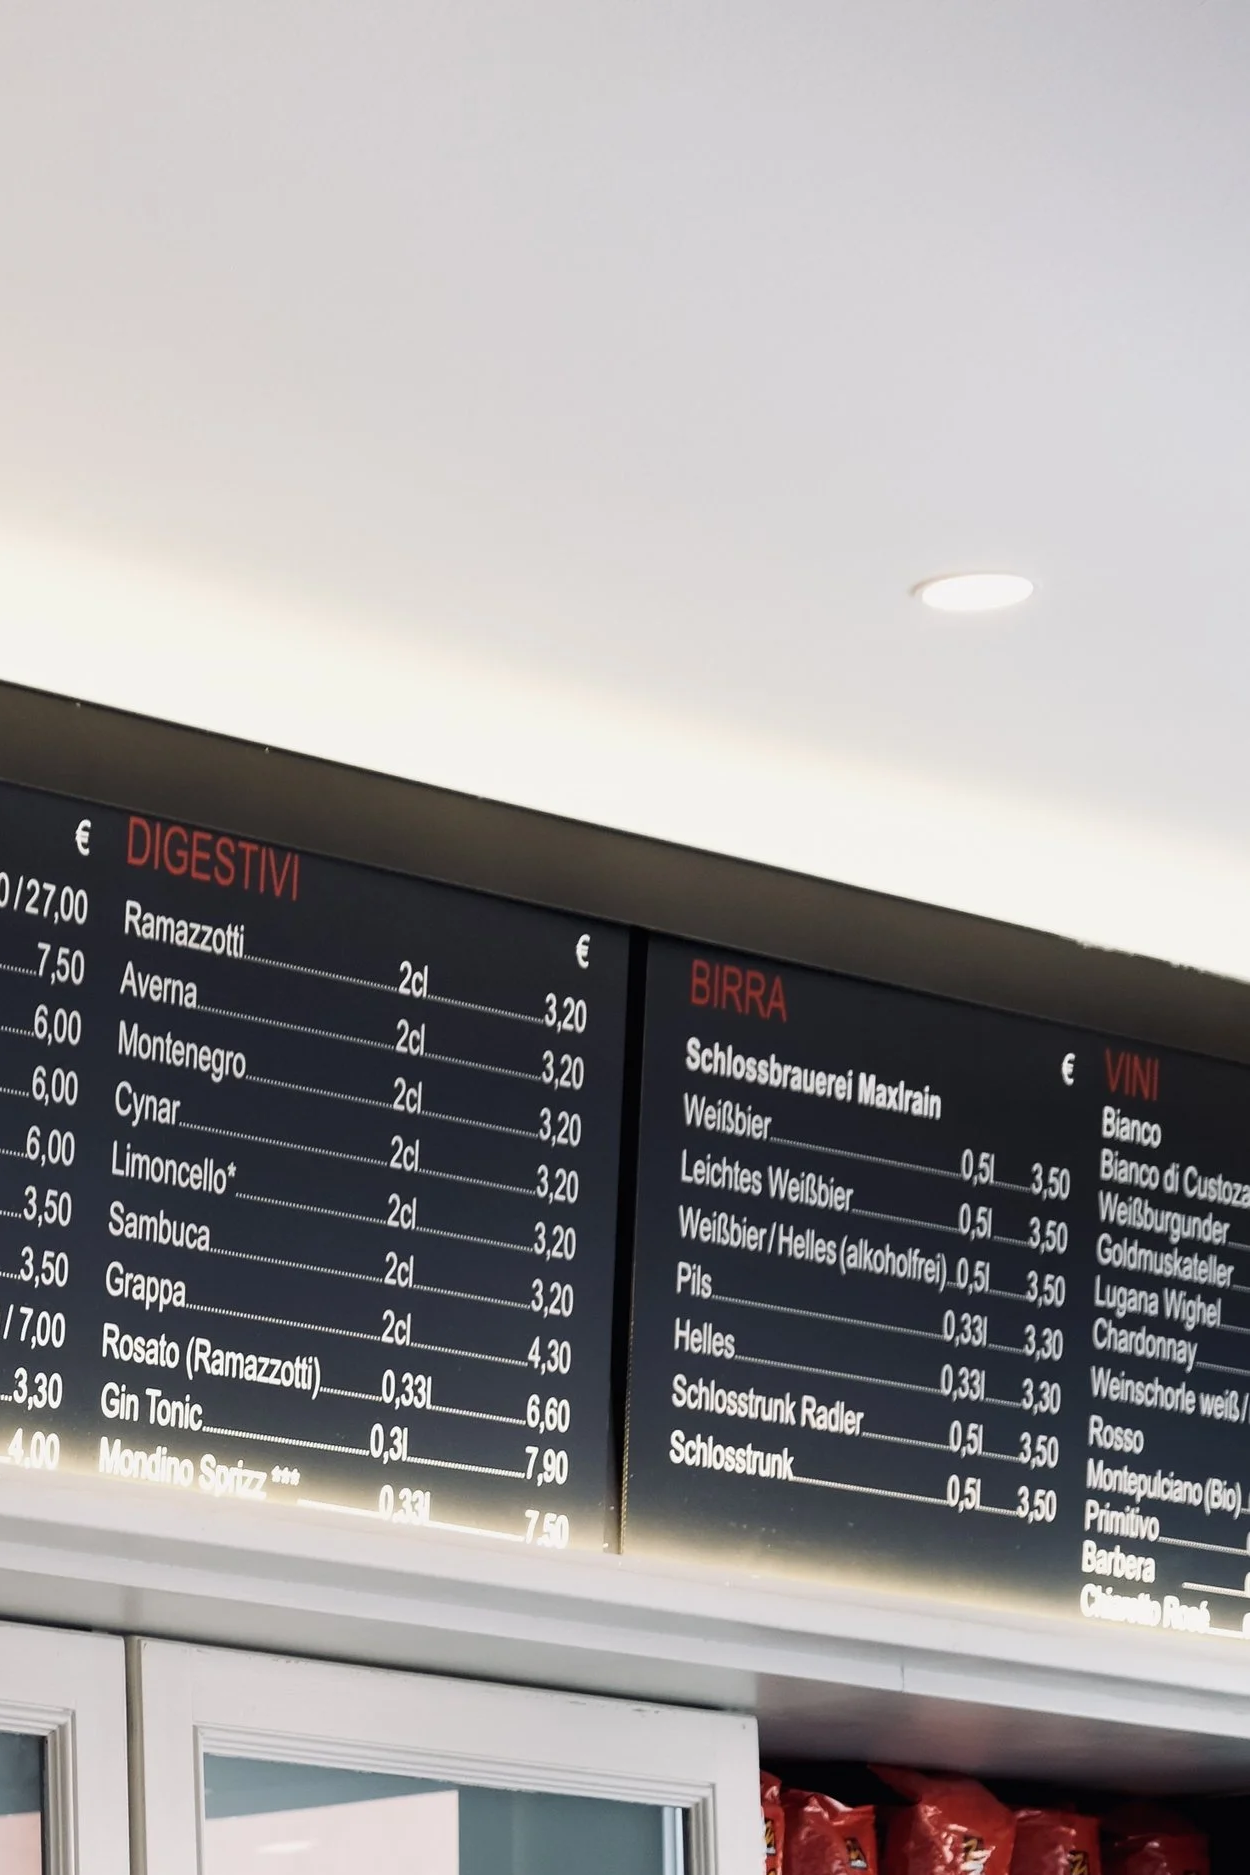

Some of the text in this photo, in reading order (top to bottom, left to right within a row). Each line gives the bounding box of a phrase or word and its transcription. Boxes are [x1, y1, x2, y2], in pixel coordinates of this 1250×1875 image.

[76, 820, 91, 855] €
[128, 817, 298, 900] DIGESTIVI
[38, 943, 84, 984] 7,50
[125, 900, 586, 1032] Ramazzotti 2cl 3,20
[576, 934, 590, 968] €
[691, 960, 786, 1021] BIRRA
[35, 1005, 81, 1045] 6,00
[120, 961, 584, 1089] Averna 2cl 3,20
[33, 1066, 78, 1105] 6,00
[119, 1021, 581, 1146] Montenegro 2cl 3,20
[686, 1037, 941, 1119] Schlossbrauerei Maxlrain
[1062, 1053, 1075, 1085] €
[1106, 1049, 1158, 1100] VINI
[25, 1126, 74, 1166] 6,00
[116, 1081, 578, 1203] Cynar 2cl 3,20
[684, 1093, 1070, 1199] Weißbier 0,5l 3,50
[1103, 1106, 1161, 1147] Bianco
[1101, 1148, 1159, 1189] Bianco
[1164, 1163, 1179, 1192] di
[24, 1186, 71, 1227] 3,50
[387, 1194, 416, 1229] 2cl
[534, 1222, 576, 1260] 3,20
[682, 1149, 1067, 1253] Leichtes Weißbier 0,5l 3,50
[1099, 1191, 1230, 1244] Weißburgunder
[20, 1246, 68, 1288] 3,50
[109, 1201, 573, 1317] Sambuca 2cl 3,20
[840, 1236, 946, 1292] (alkoholfrei)
[957, 1258, 989, 1294] 0,5l
[1026, 1271, 1065, 1307] 3,50
[1097, 1233, 1234, 1287] Goldmuskateller
[106, 1262, 571, 1374] Grappa 2cl 4,30
[677, 1262, 1063, 1360] Pils 0,33l 3,30
[1095, 1275, 1221, 1331] Lugana Wighel
[675, 1318, 1060, 1414] Helles 0,33l 3,30
[1093, 1318, 1197, 1372] Chardonnay
[13, 1368, 62, 1410] 3,30
[103, 1323, 570, 1433] Rosato (Ramazzotti) 0,33l 6,60
[1091, 1366, 1195, 1414] Weinschorle
[101, 1382, 568, 1486] Gin Tonic 0,3l 7,90
[672, 1374, 1058, 1468] Schlosstrunk Radler 0,5l 3,50
[1089, 1415, 1144, 1454] Rosso
[670, 1430, 1056, 1523] Schlosstrunk 0,5l 3,50
[1087, 1458, 1241, 1519] Montepulciano (Bio)
[1085, 1499, 1163, 1542] Primitivo
[1082, 1540, 1155, 1583] Barbera
